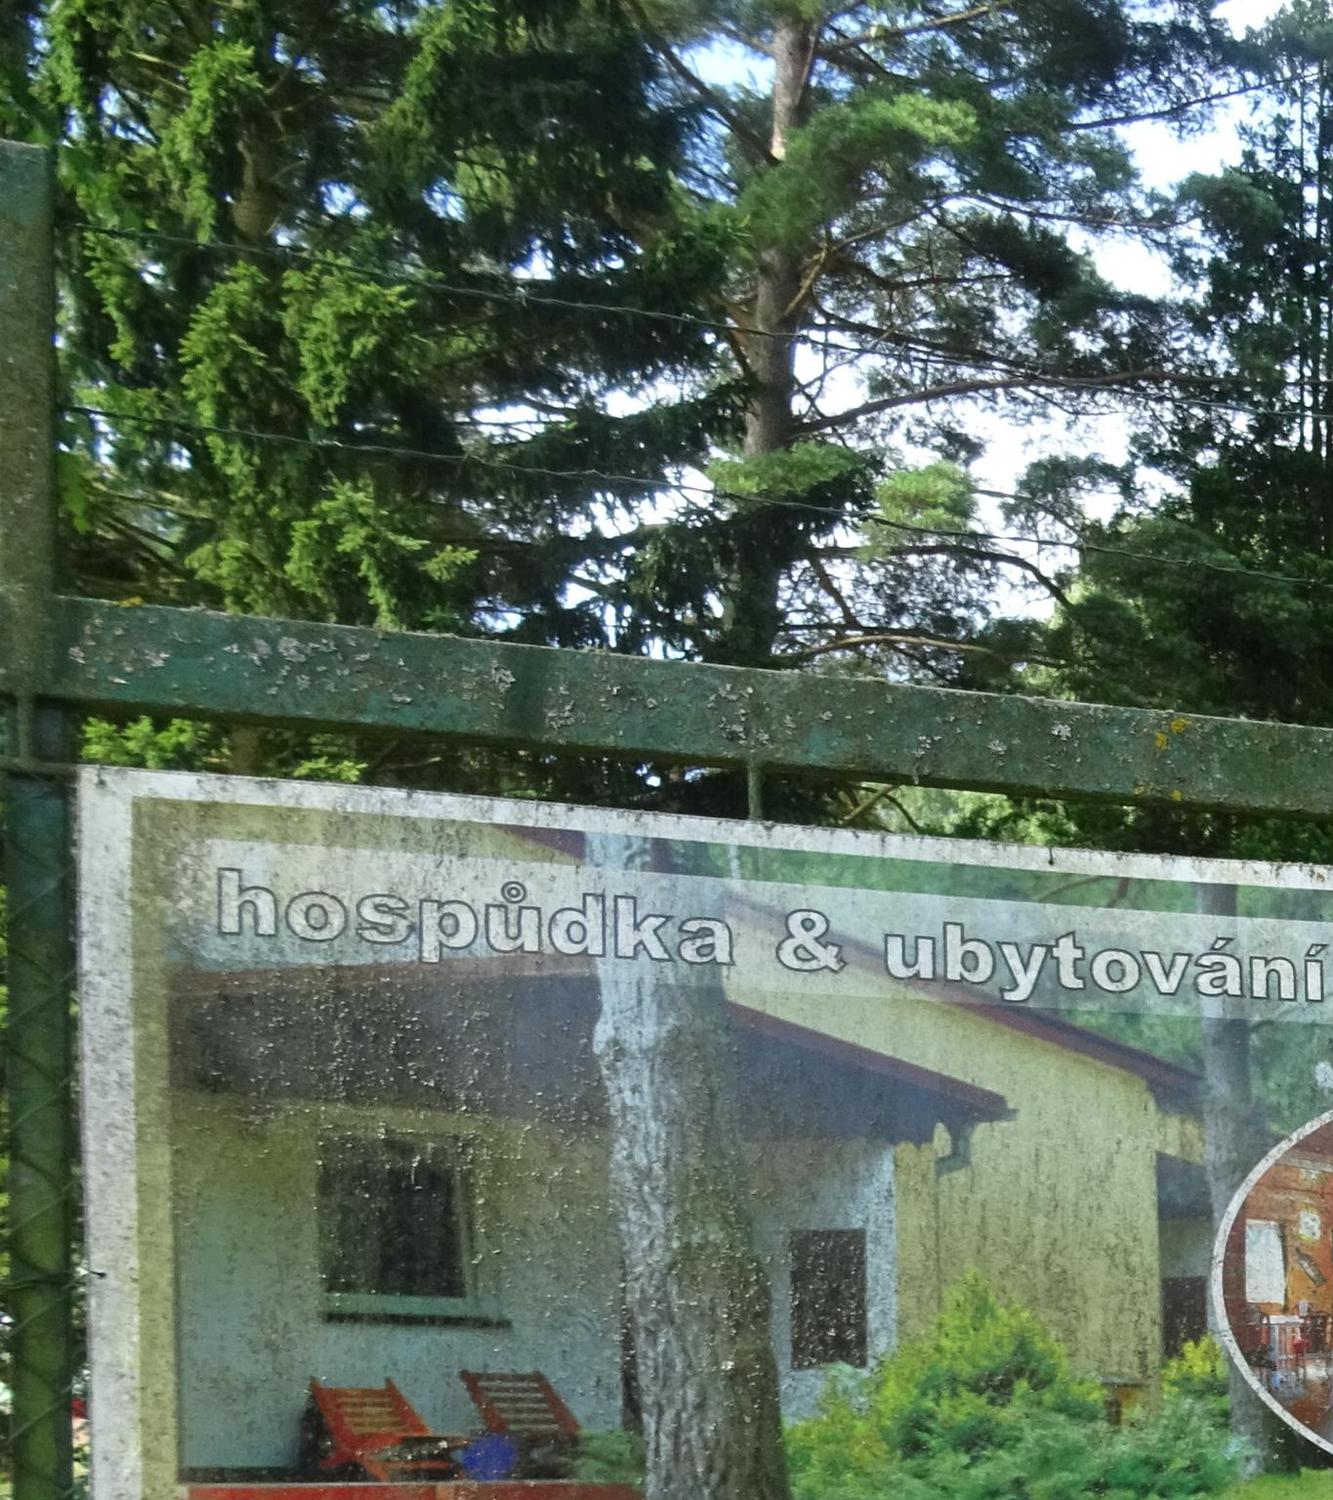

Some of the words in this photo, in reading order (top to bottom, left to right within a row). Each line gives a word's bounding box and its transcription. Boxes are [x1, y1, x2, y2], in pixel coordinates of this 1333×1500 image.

[216, 867, 735, 967] hospůdka
[775, 908, 848, 974] &
[883, 920, 1330, 1002] ubytování
